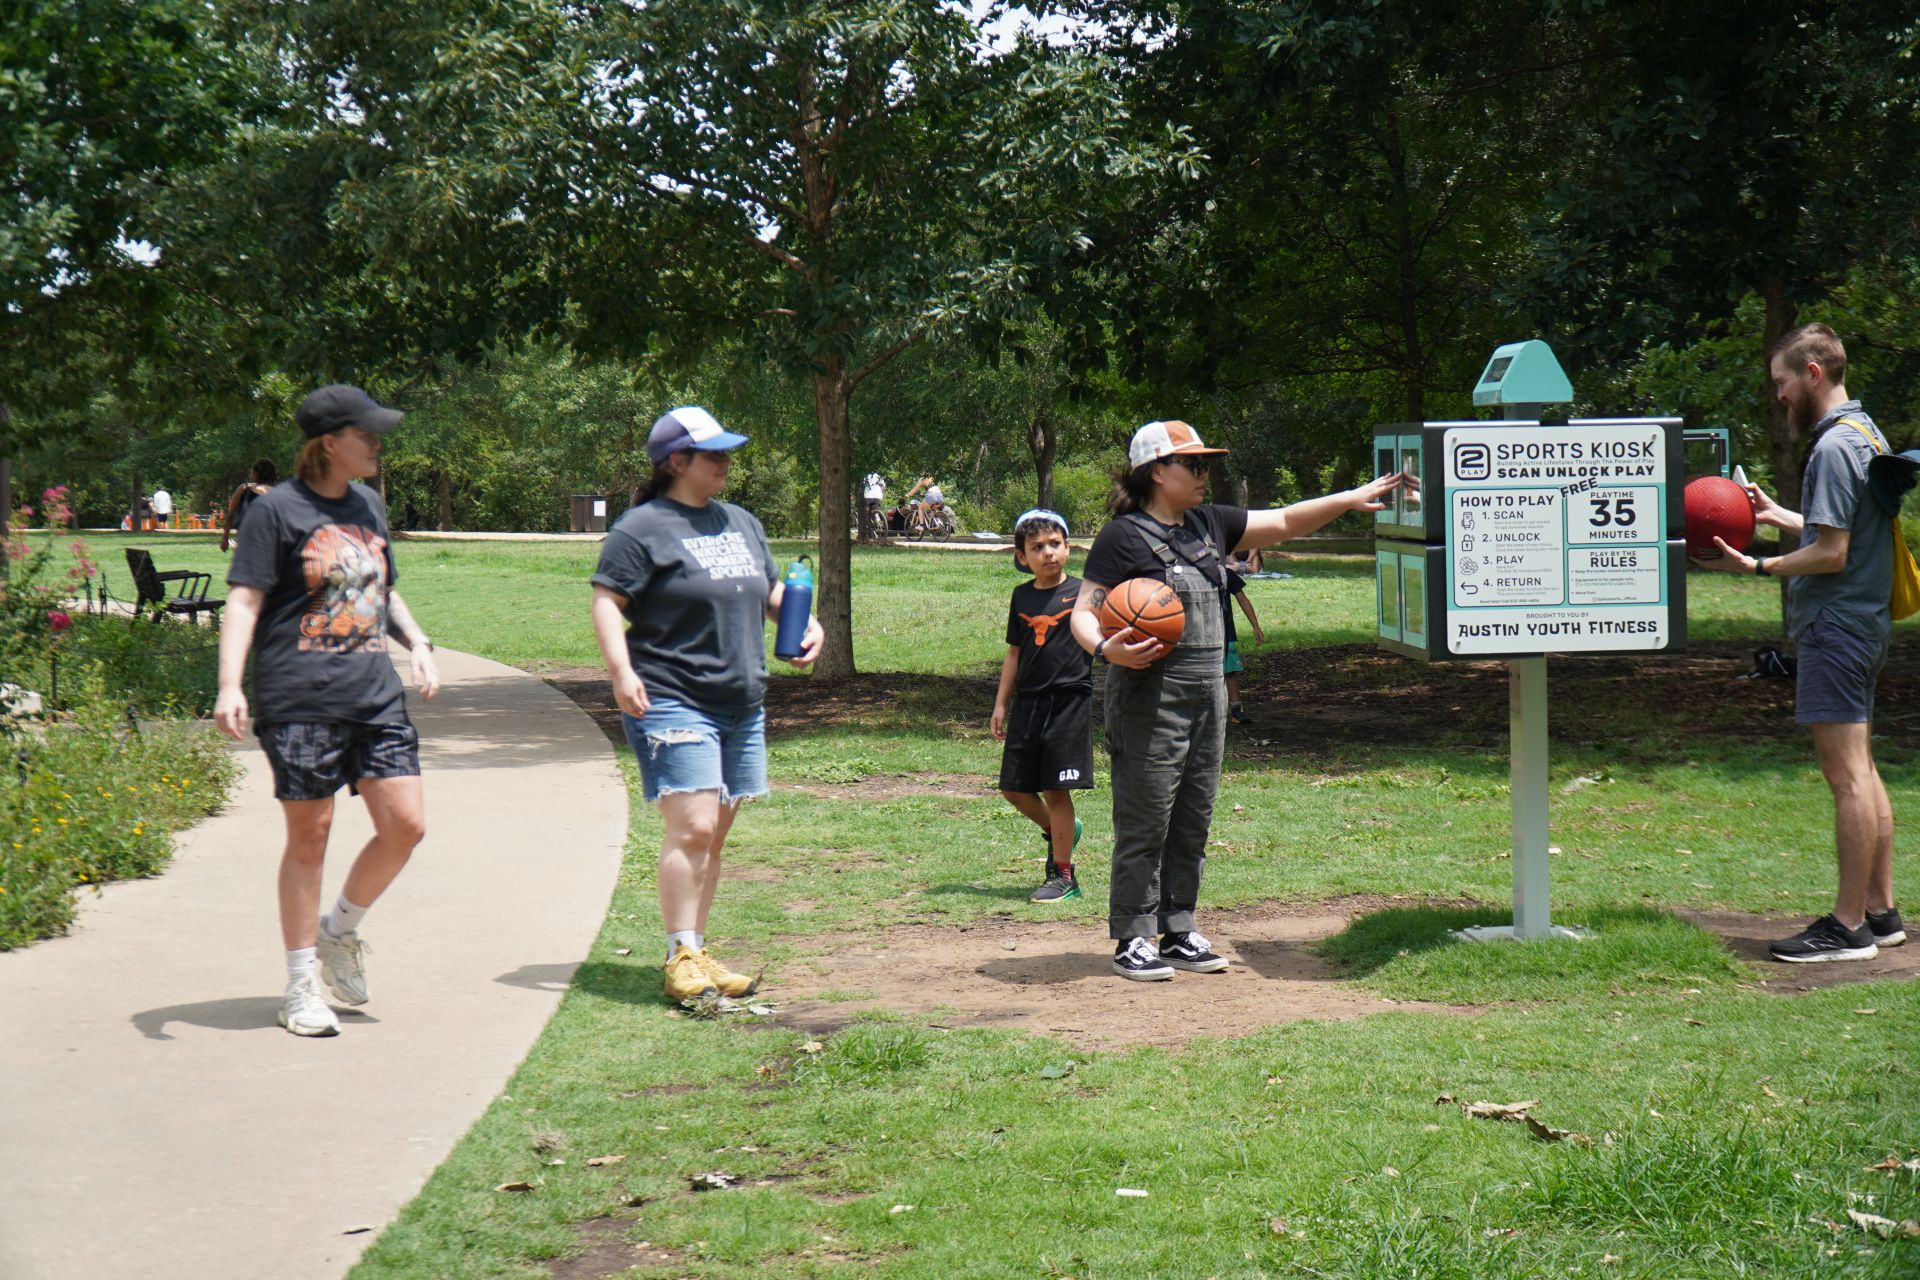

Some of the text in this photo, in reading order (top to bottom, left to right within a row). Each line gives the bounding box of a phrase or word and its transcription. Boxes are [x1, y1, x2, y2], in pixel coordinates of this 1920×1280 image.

[1497, 442, 1655, 460] SPORTS KIOSK
[1460, 449, 1484, 468] 2
[1497, 466, 1655, 478] SCAN UNLOCK PLAY
[1560, 477, 1599, 498] FREE
[1460, 495, 1554, 507] HOW TO PLAY
[1590, 491, 1634, 499] PLAYTIME
[1482, 511, 1524, 520] 1. SCAN
[1589, 499, 1636, 527] 35
[1482, 532, 1541, 542] 2. UNLOCK
[1589, 530, 1638, 539] MINUTES
[1483, 556, 1524, 565] 3. PLAY
[1590, 557, 1637, 568] RULES
[1483, 578, 1542, 587] 4. RETURN
[1458, 620, 1657, 638] AUSTIN YOUTH FITNESS
[1059, 769, 1080, 781] GAP
